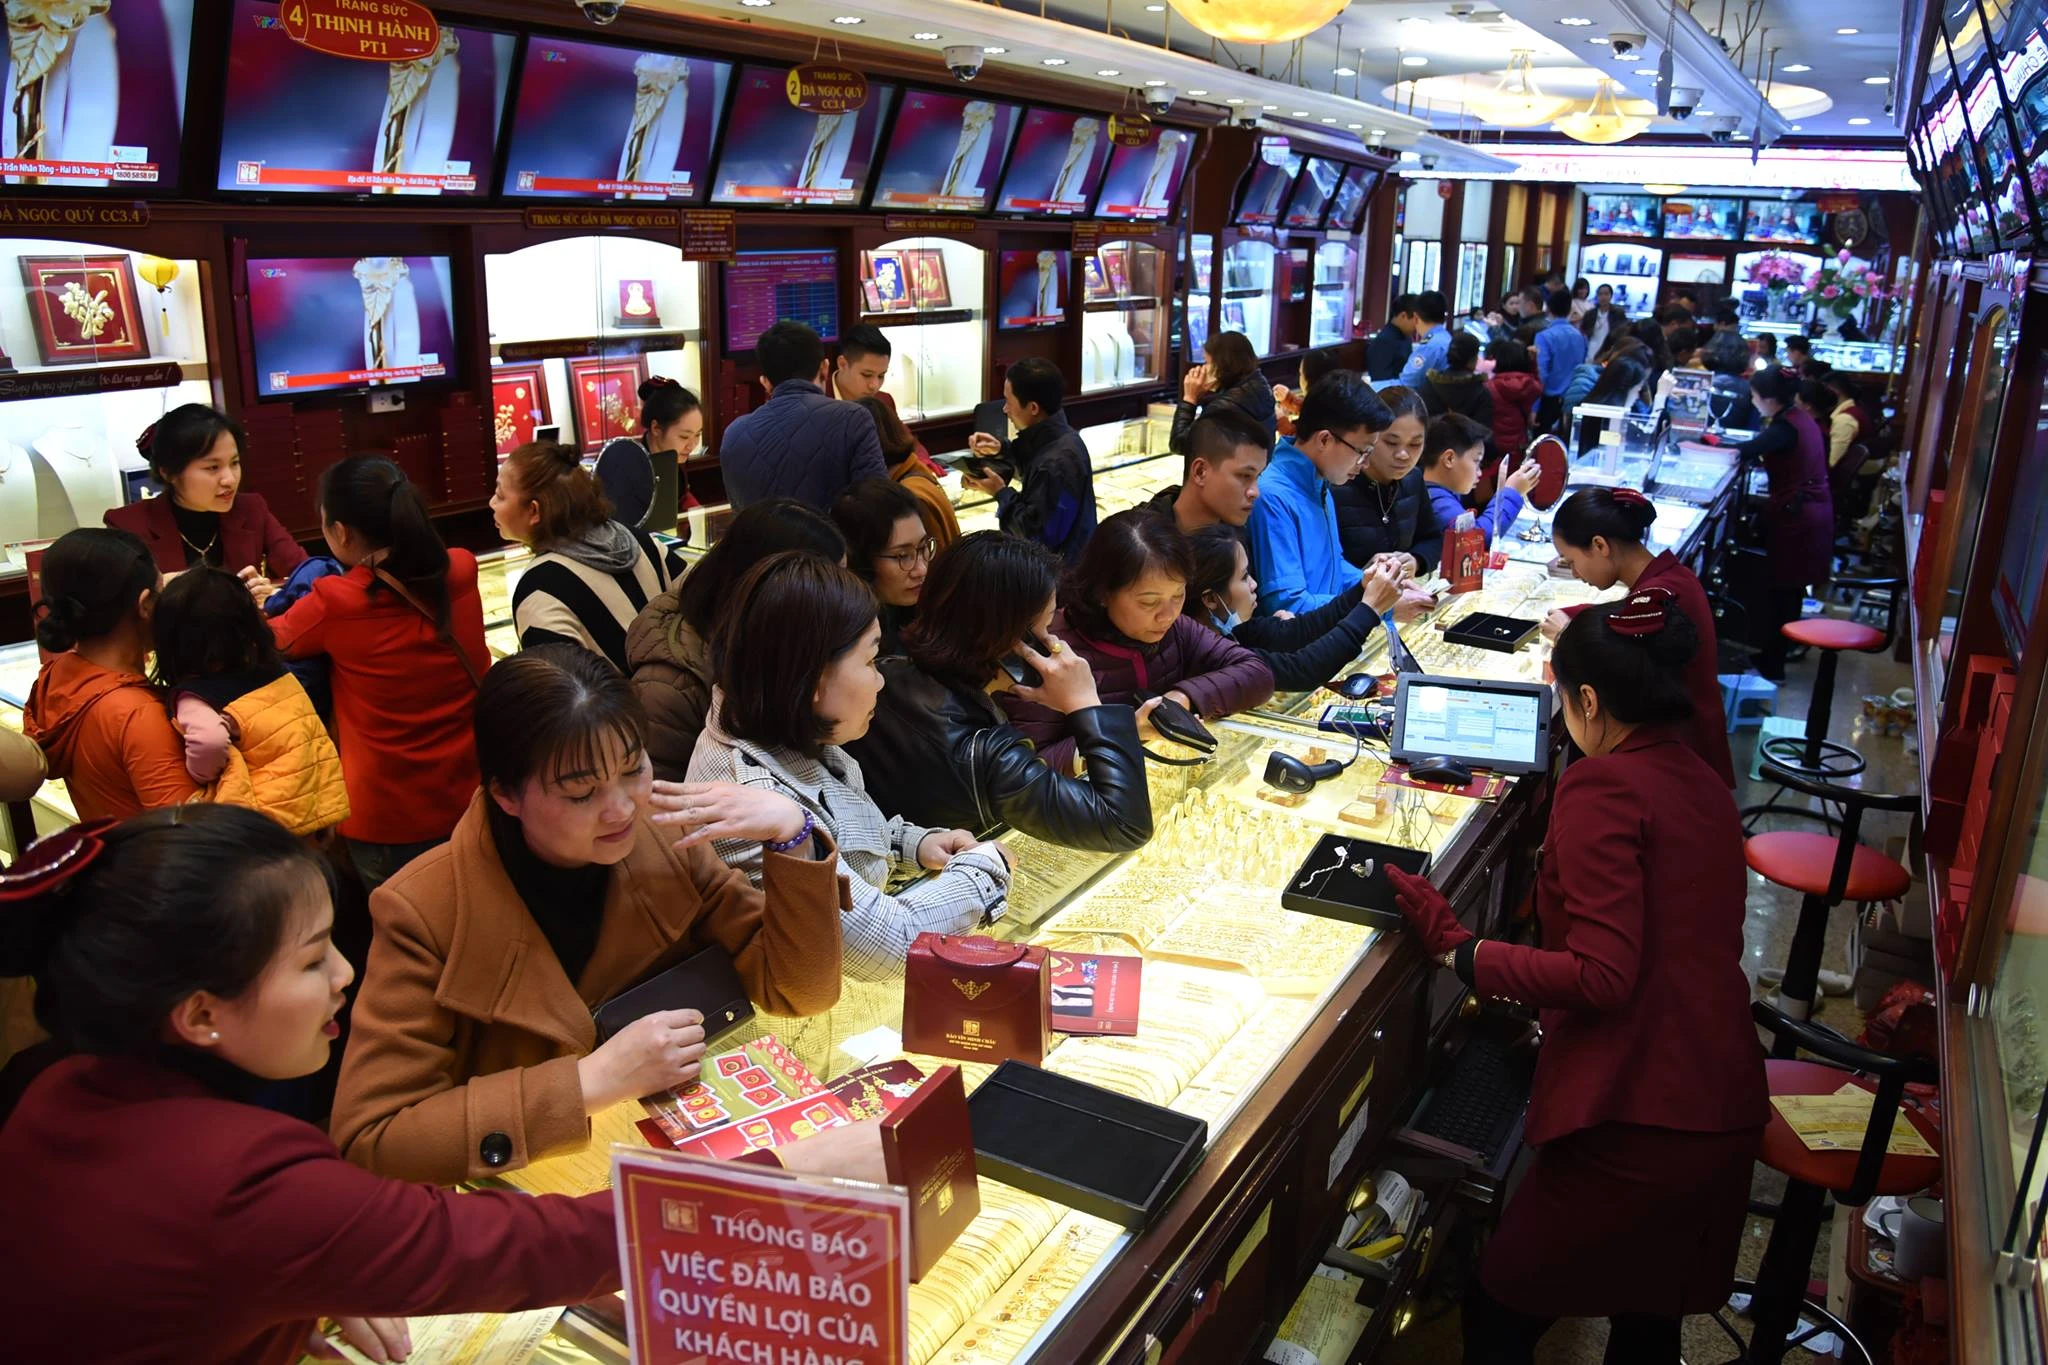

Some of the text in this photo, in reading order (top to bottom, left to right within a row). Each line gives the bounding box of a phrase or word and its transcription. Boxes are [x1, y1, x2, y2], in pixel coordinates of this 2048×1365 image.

[289, 5, 431, 42] 4 THỊNH HÀNH
[335, 0, 409, 17] TRANG SỨC
[360, 39, 389, 55] PT1
[790, 80, 797, 95] 2
[0, 204, 140, 224] Á NGỌC QUÝ CC3.4
[711, 1214, 804, 1249] THÔNG
[811, 1230, 868, 1259] BÁO
[661, 1249, 872, 1307] VIỆC ĐẢM BẢO
[765, 1306, 811, 1340] LỢI
[818, 1312, 879, 1348] CỦA
[675, 1328, 773, 1365] KHÁCH
